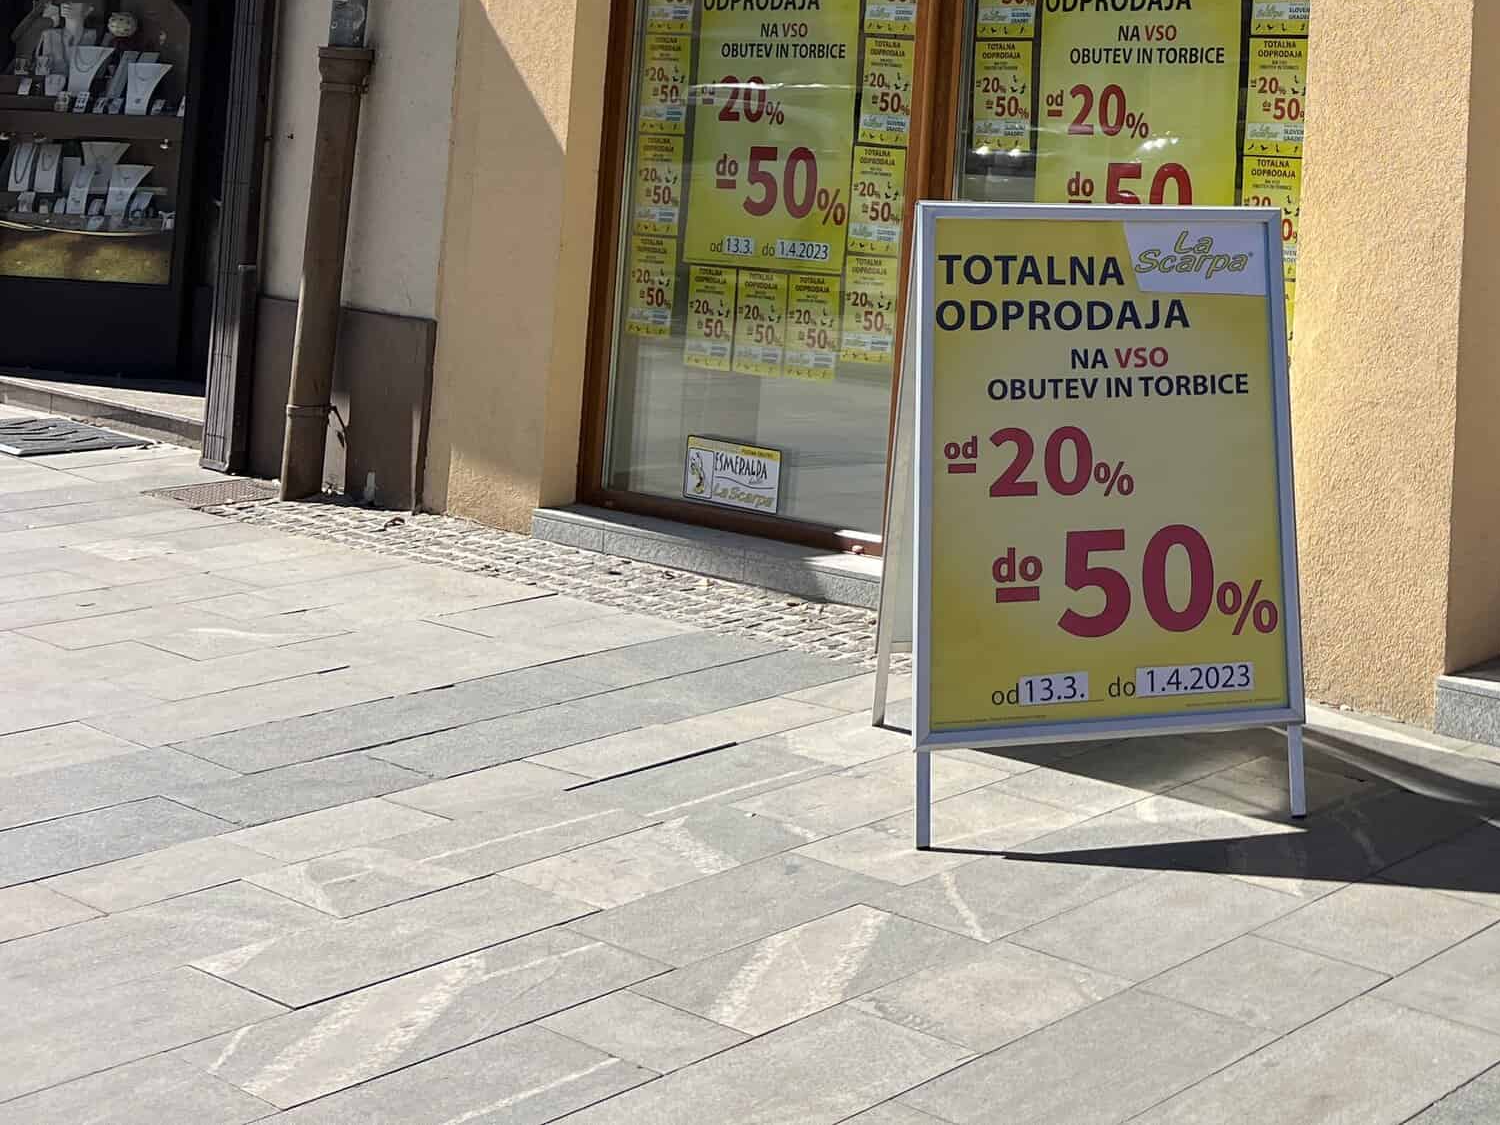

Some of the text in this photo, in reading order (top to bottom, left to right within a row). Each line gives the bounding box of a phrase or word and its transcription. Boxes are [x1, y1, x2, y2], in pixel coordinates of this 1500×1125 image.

[760, 23, 808, 38] NA VSO
[1118, 25, 1177, 42] NA VSO
[721, 43, 846, 59] OBUTEV IN TORBICE
[1070, 47, 1225, 65] OBUTEV IN TORBICE
[1258, 49, 1302, 59] ODPRODAJA
[1264, 41, 1296, 49] TOTALNA
[718, 75, 784, 125] 20%
[995, 96, 1029, 118] 50%
[1046, 84, 1149, 139] od 20%
[716, 146, 846, 226] do 50%
[1067, 172, 1094, 197] do
[710, 237, 829, 259] od 13.3. do 1.4.2023
[1174, 230, 1213, 253] La
[939, 254, 1125, 287] TOTALNA
[1135, 249, 1249, 279] Scarpa
[936, 299, 1190, 331] ODPRODAJA
[1071, 347, 1169, 370] NA VSO
[987, 374, 1249, 401] OBUTEV IN TORBICE
[715, 452, 767, 479] ESMERALDA
[944, 425, 1135, 498] od 20%
[992, 524, 1278, 638] do 50%
[991, 665, 1251, 707] od 13.3. do 1.4.2023
